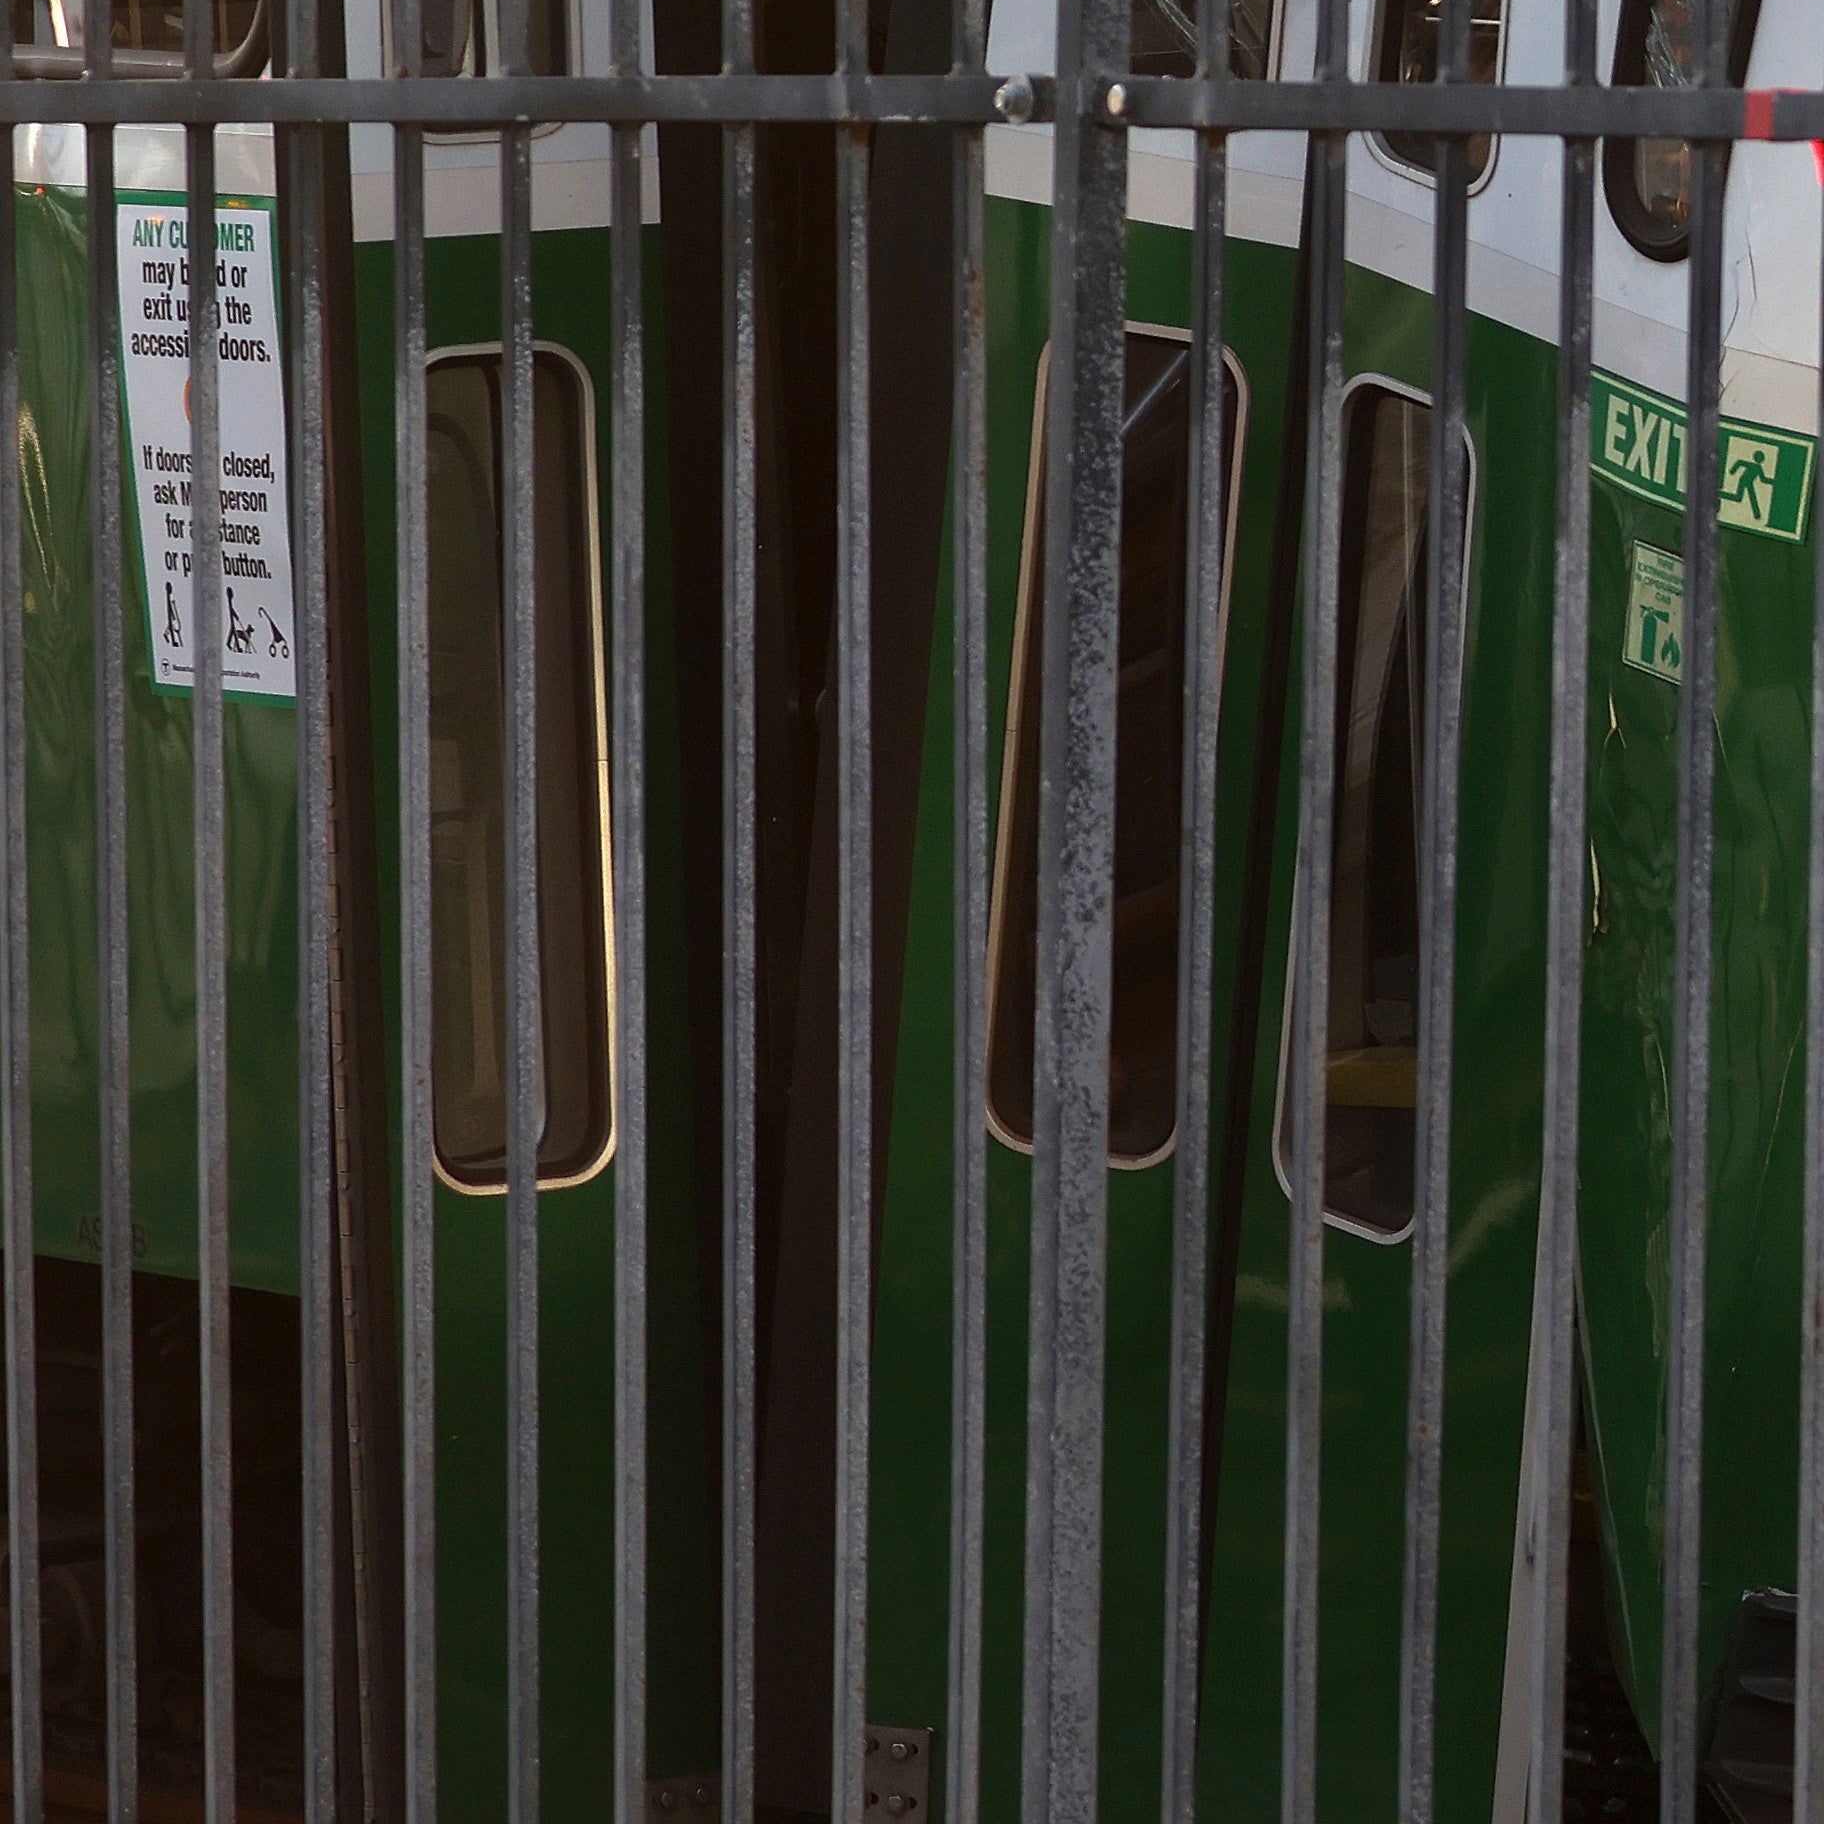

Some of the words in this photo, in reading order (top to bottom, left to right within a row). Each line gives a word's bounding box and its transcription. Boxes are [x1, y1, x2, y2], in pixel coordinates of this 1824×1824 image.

[133, 219, 165, 248] ANY
[169, 220, 255, 252] CUMER
[143, 260, 174, 290] may
[231, 265, 247, 288] or
[143, 292, 172, 321] exit
[225, 296, 251, 325] the
[131, 329, 189, 358] accessi
[219, 332, 271, 362] doors.
[1603, 393, 1688, 494] EXIT
[222, 451, 275, 484] closed,
[154, 480, 178, 505] ask
[219, 489, 267, 514] person
[166, 512, 184, 539] for
[165, 551, 178, 571] or
[222, 551, 272, 579] button.
